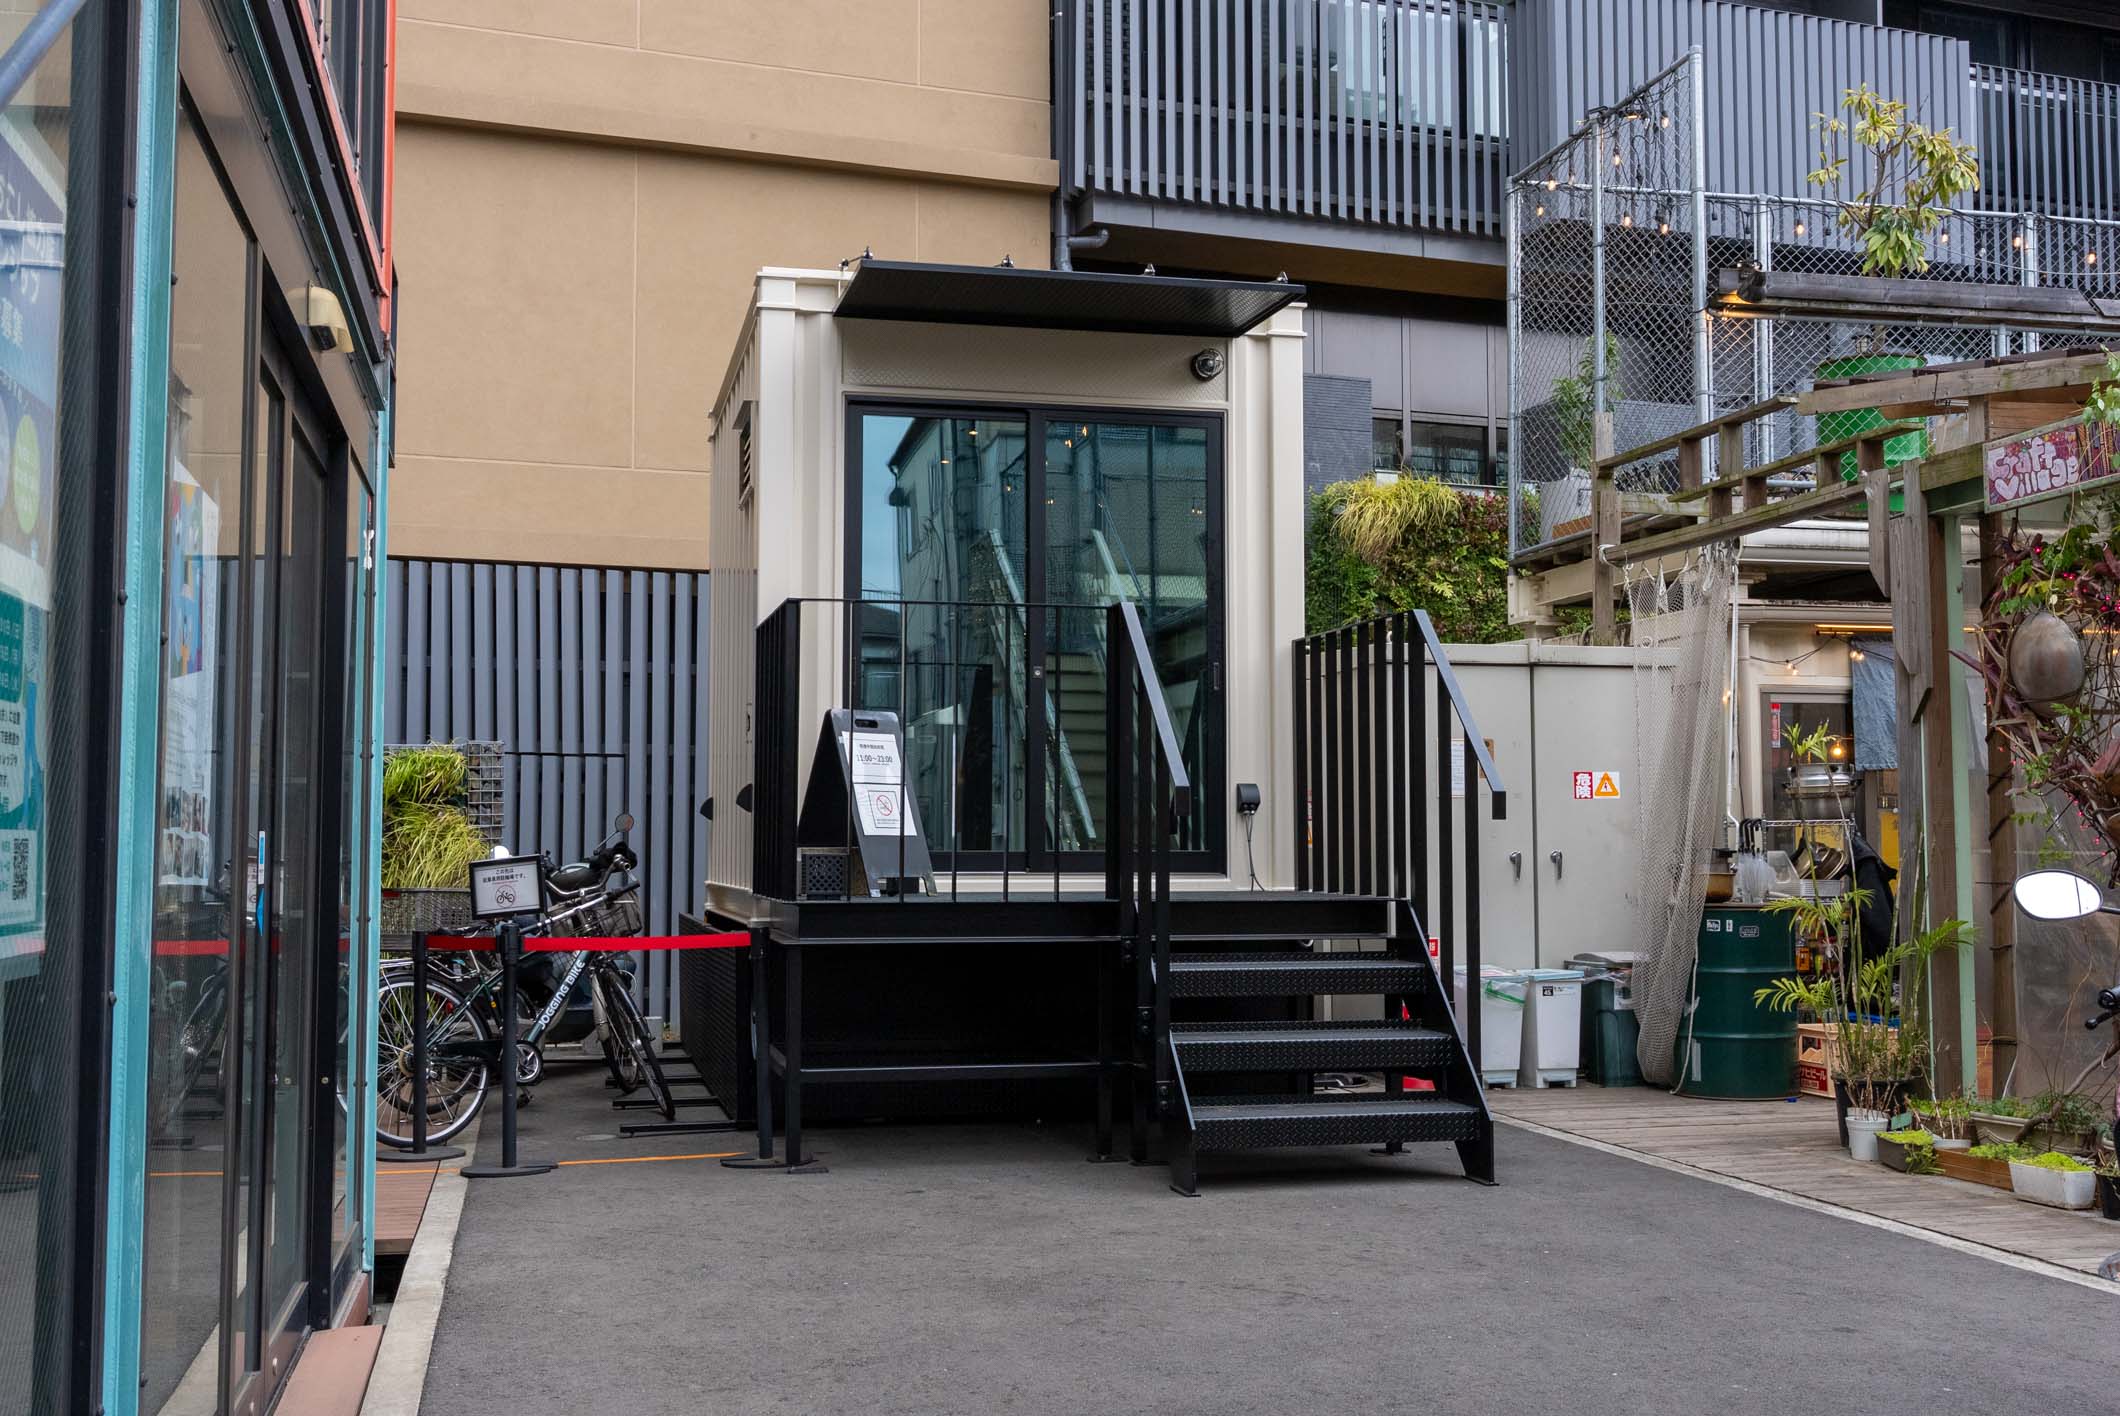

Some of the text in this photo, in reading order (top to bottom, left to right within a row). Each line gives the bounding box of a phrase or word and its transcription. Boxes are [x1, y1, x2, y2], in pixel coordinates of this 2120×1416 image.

[1575, 773, 1592, 798] 危険
[538, 959, 586, 1030] JOGGING BIKE
